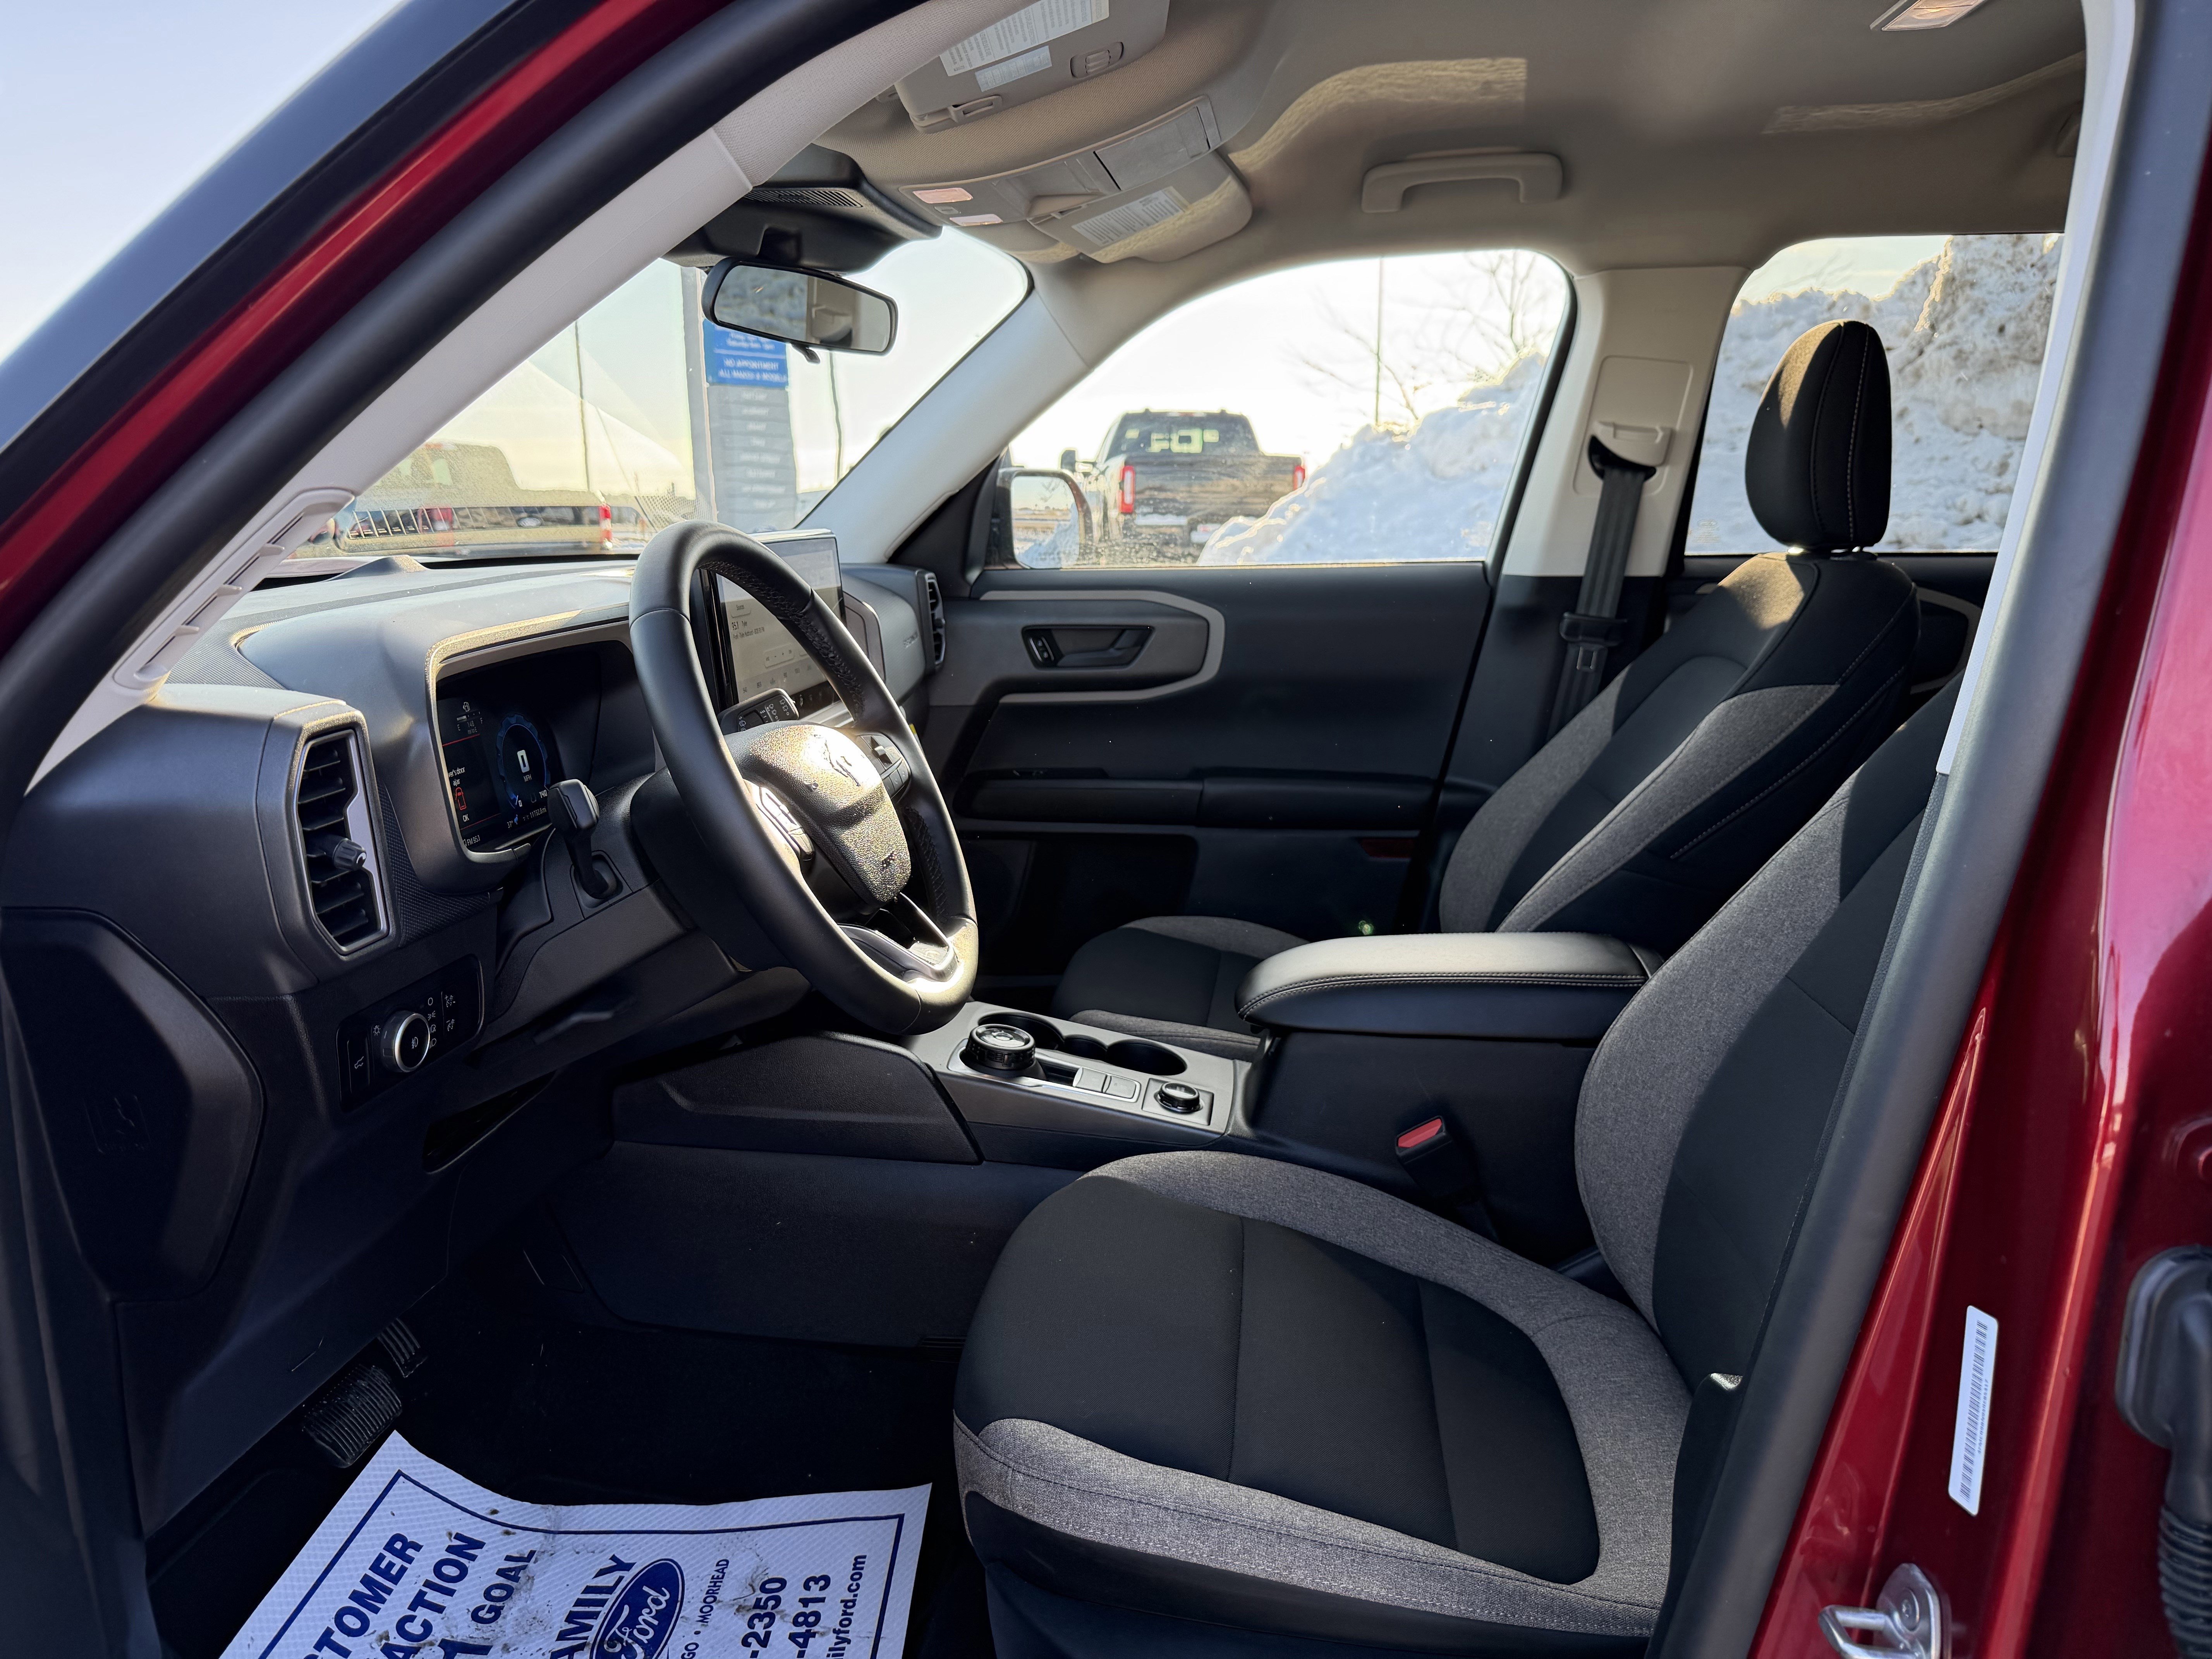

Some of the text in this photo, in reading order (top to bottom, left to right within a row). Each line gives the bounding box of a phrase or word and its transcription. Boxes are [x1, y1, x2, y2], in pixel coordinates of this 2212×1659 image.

[453, 778, 461, 787] ajar
[457, 766, 465, 775] door
[523, 774, 532, 782] MPH
[539, 789, 548, 799] 140
[462, 813, 470, 822] OK
[471, 1549, 537, 1625] GOAL
[696, 1558, 730, 1624] MOORHEAD
[603, 1585, 671, 1659] Ford
[741, 1577, 787, 1659] -2350
[788, 1574, 831, 1659] -4813
